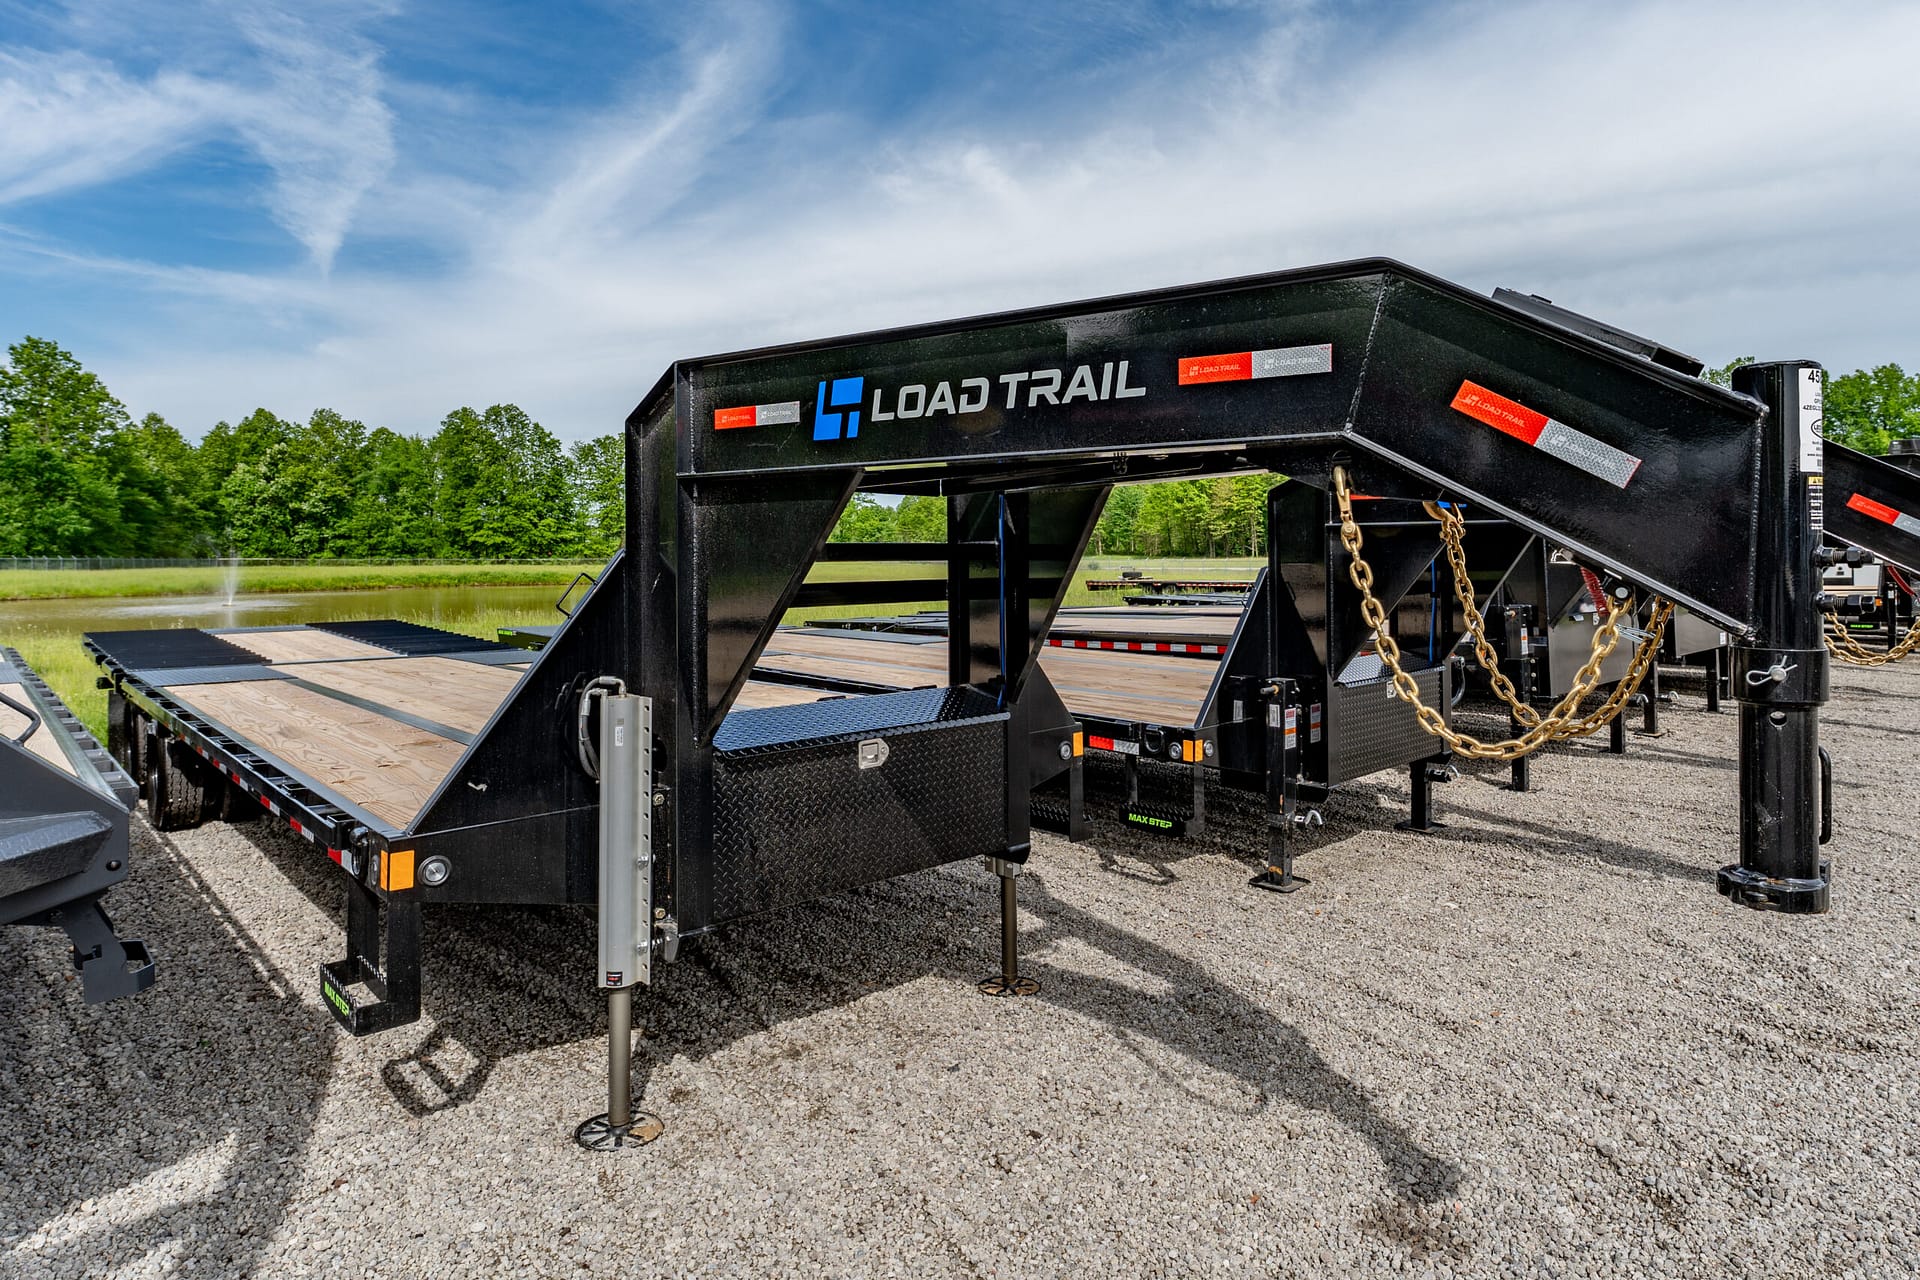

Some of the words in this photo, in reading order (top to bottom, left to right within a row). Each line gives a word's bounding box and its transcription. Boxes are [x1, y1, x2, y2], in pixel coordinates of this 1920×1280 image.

[1199, 366, 1219, 374] LOAD
[1220, 364, 1241, 372] TRAIL
[871, 377, 989, 422] LOAD
[999, 360, 1147, 409] TRAIL
[1477, 400, 1501, 416] LOAD
[1501, 411, 1525, 428] TRAIL
[1128, 812, 1149, 825] MAX
[1148, 817, 1172, 829] STEP
[324, 981, 336, 1004] MAX
[335, 993, 350, 1017] STEP
